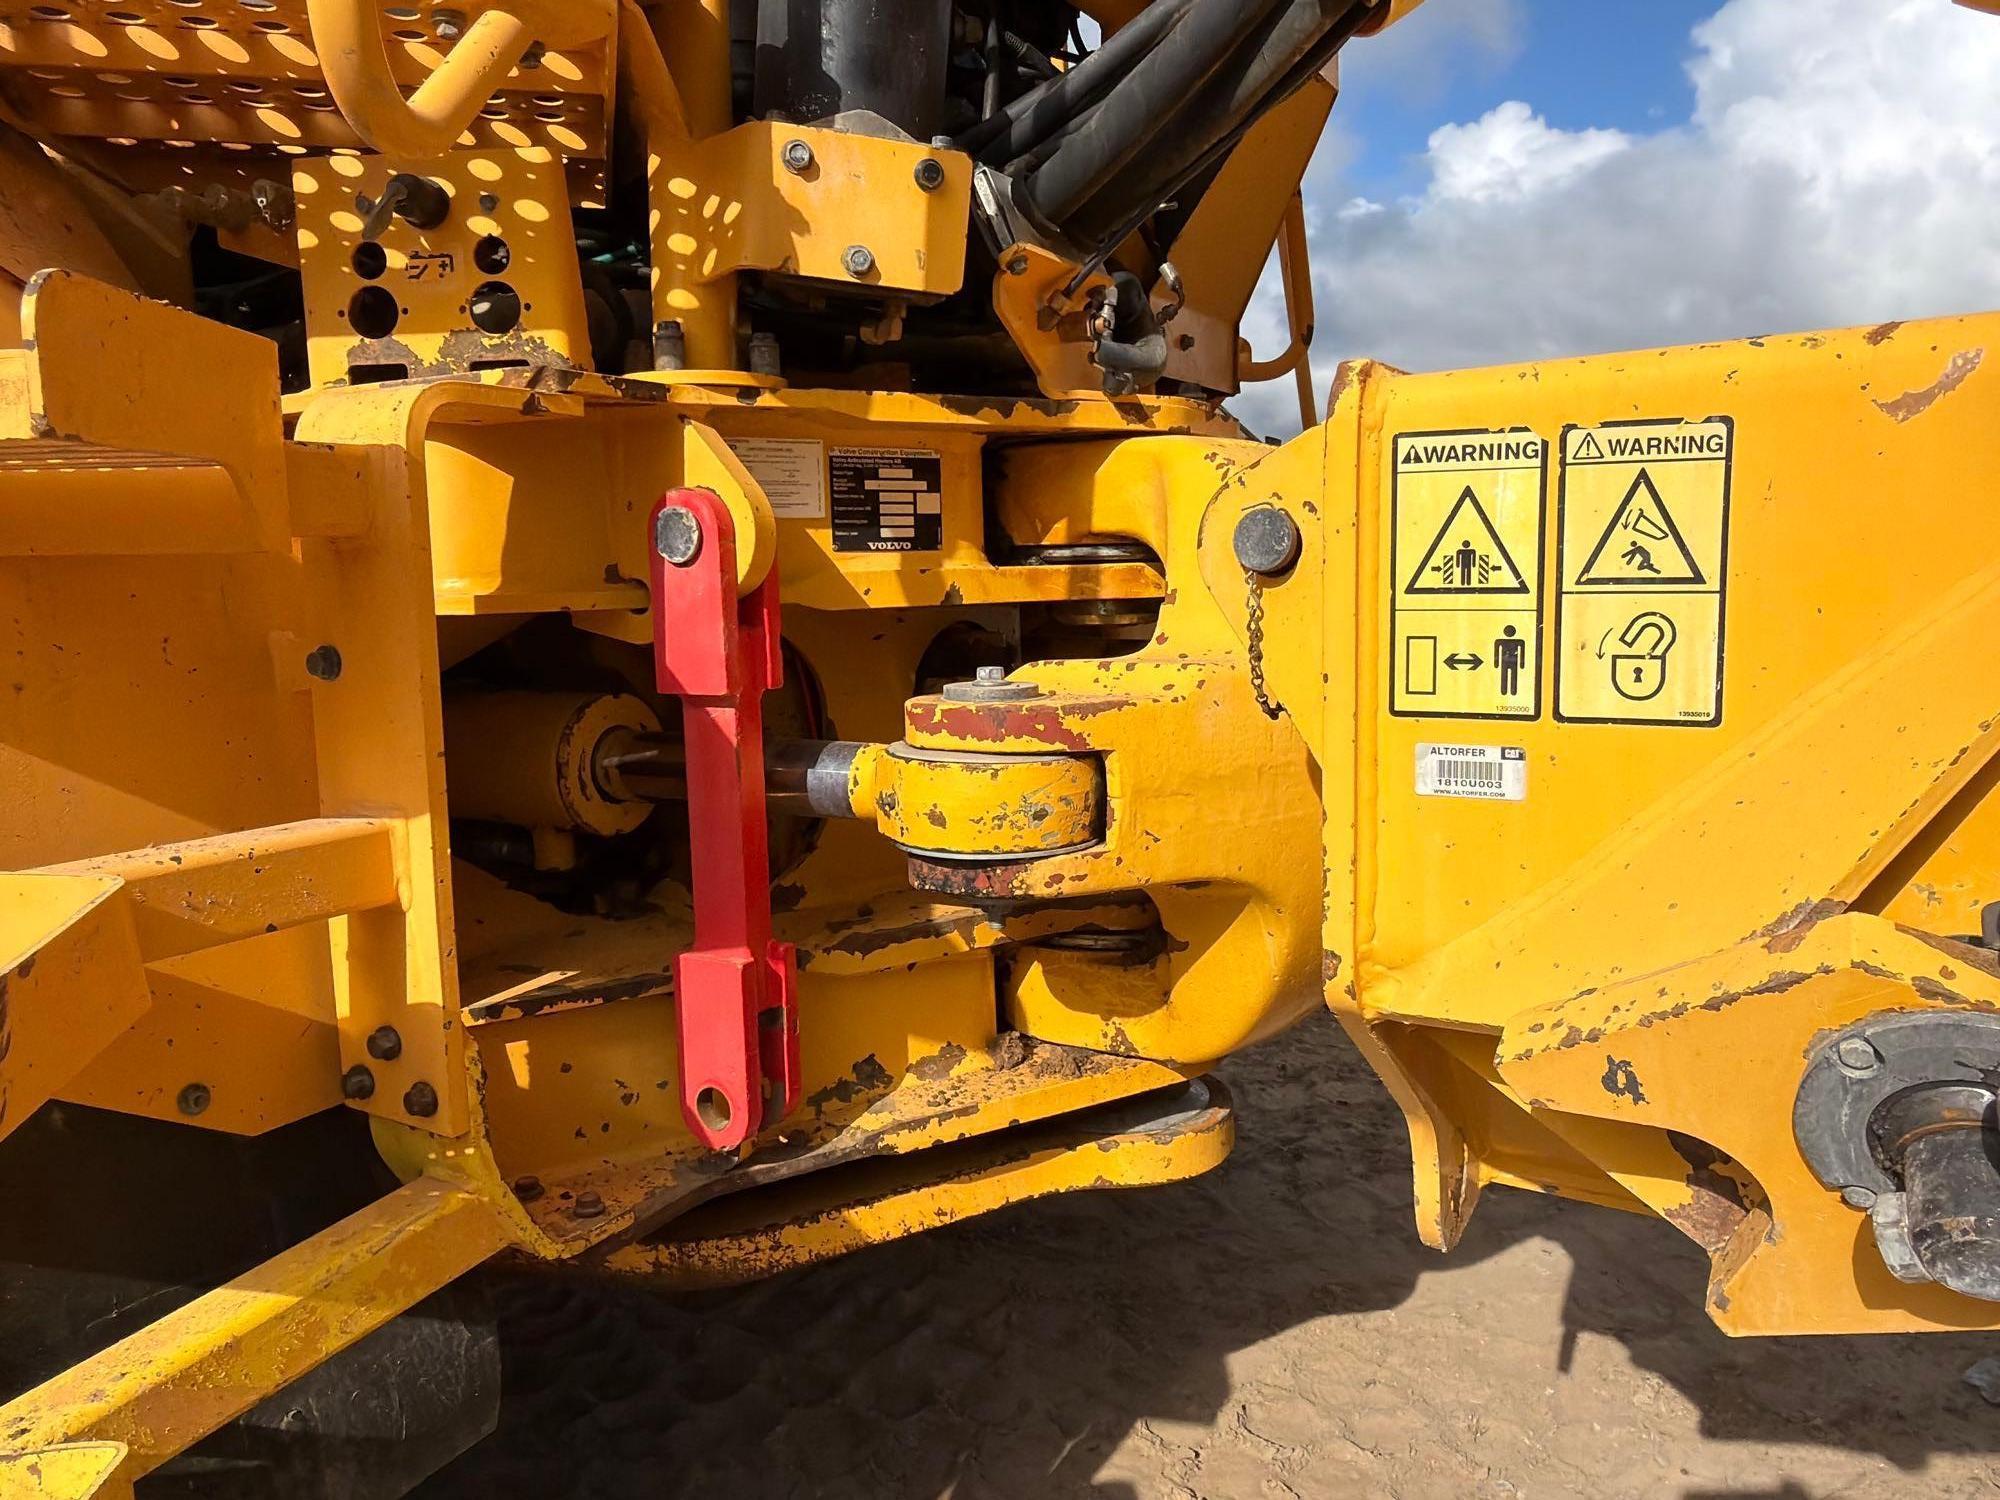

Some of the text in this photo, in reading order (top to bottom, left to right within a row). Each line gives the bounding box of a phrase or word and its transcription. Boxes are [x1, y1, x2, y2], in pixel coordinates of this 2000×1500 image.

[1608, 434, 1724, 456] WARNING
[1423, 441, 1540, 463] WARNING
[867, 542, 912, 550] VOLVO
[1430, 747, 1486, 757] ALTORFER
[1437, 778, 1502, 789] 1810U003
[1433, 788, 1506, 797] WWW.ALTORFER.COM
